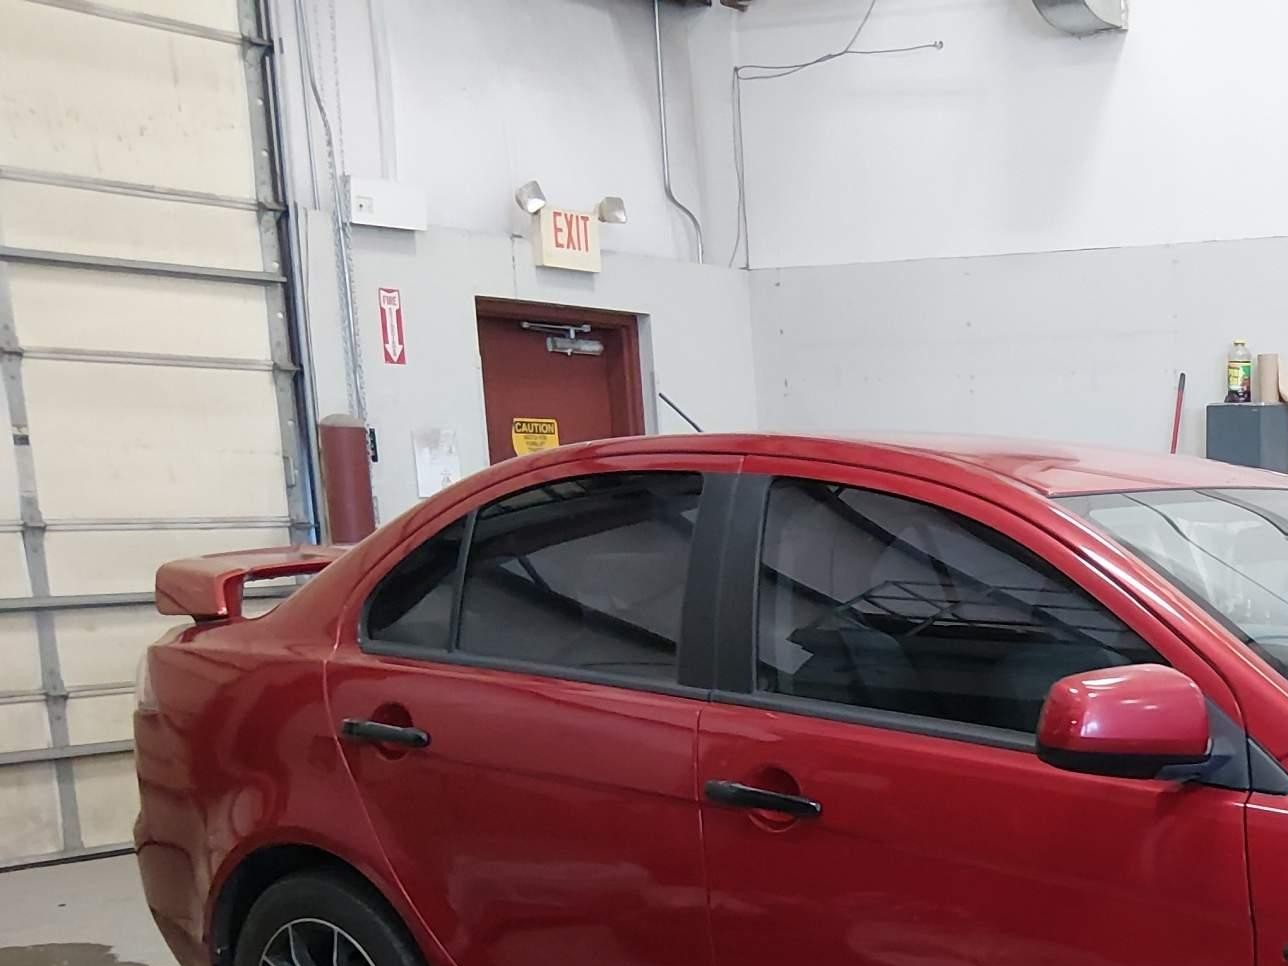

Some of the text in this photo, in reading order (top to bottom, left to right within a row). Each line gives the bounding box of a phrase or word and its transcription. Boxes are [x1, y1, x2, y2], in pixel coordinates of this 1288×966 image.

[553, 211, 589, 252] EXIT
[383, 296, 397, 305] FIRE
[515, 422, 554, 433] CAUTION
